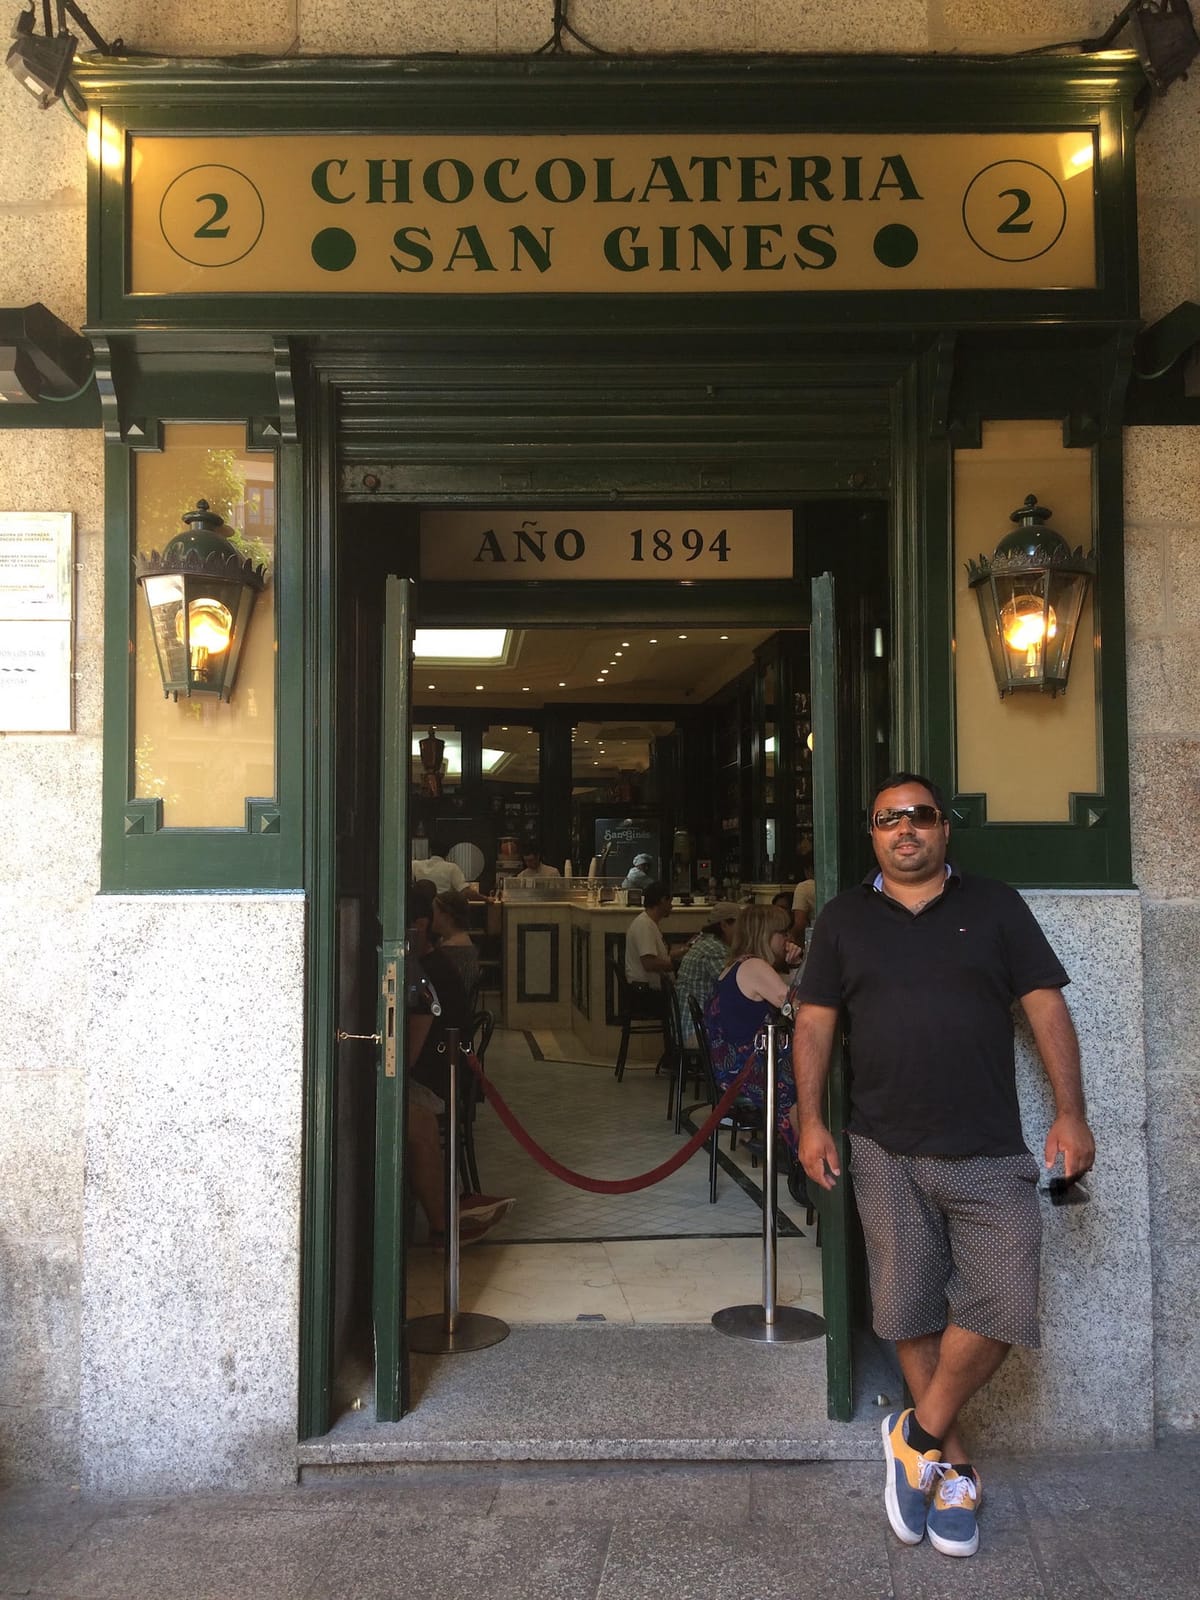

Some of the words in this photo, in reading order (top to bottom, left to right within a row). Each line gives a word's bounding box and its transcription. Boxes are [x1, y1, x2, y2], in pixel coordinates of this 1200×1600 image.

[311, 153, 925, 205] CHOCOLATERIA
[194, 193, 229, 238] 2
[996, 188, 1034, 234] 2
[390, 224, 555, 273] SAN
[603, 223, 838, 272] GINES
[473, 521, 586, 562] AÑO
[630, 528, 732, 562] 1894
